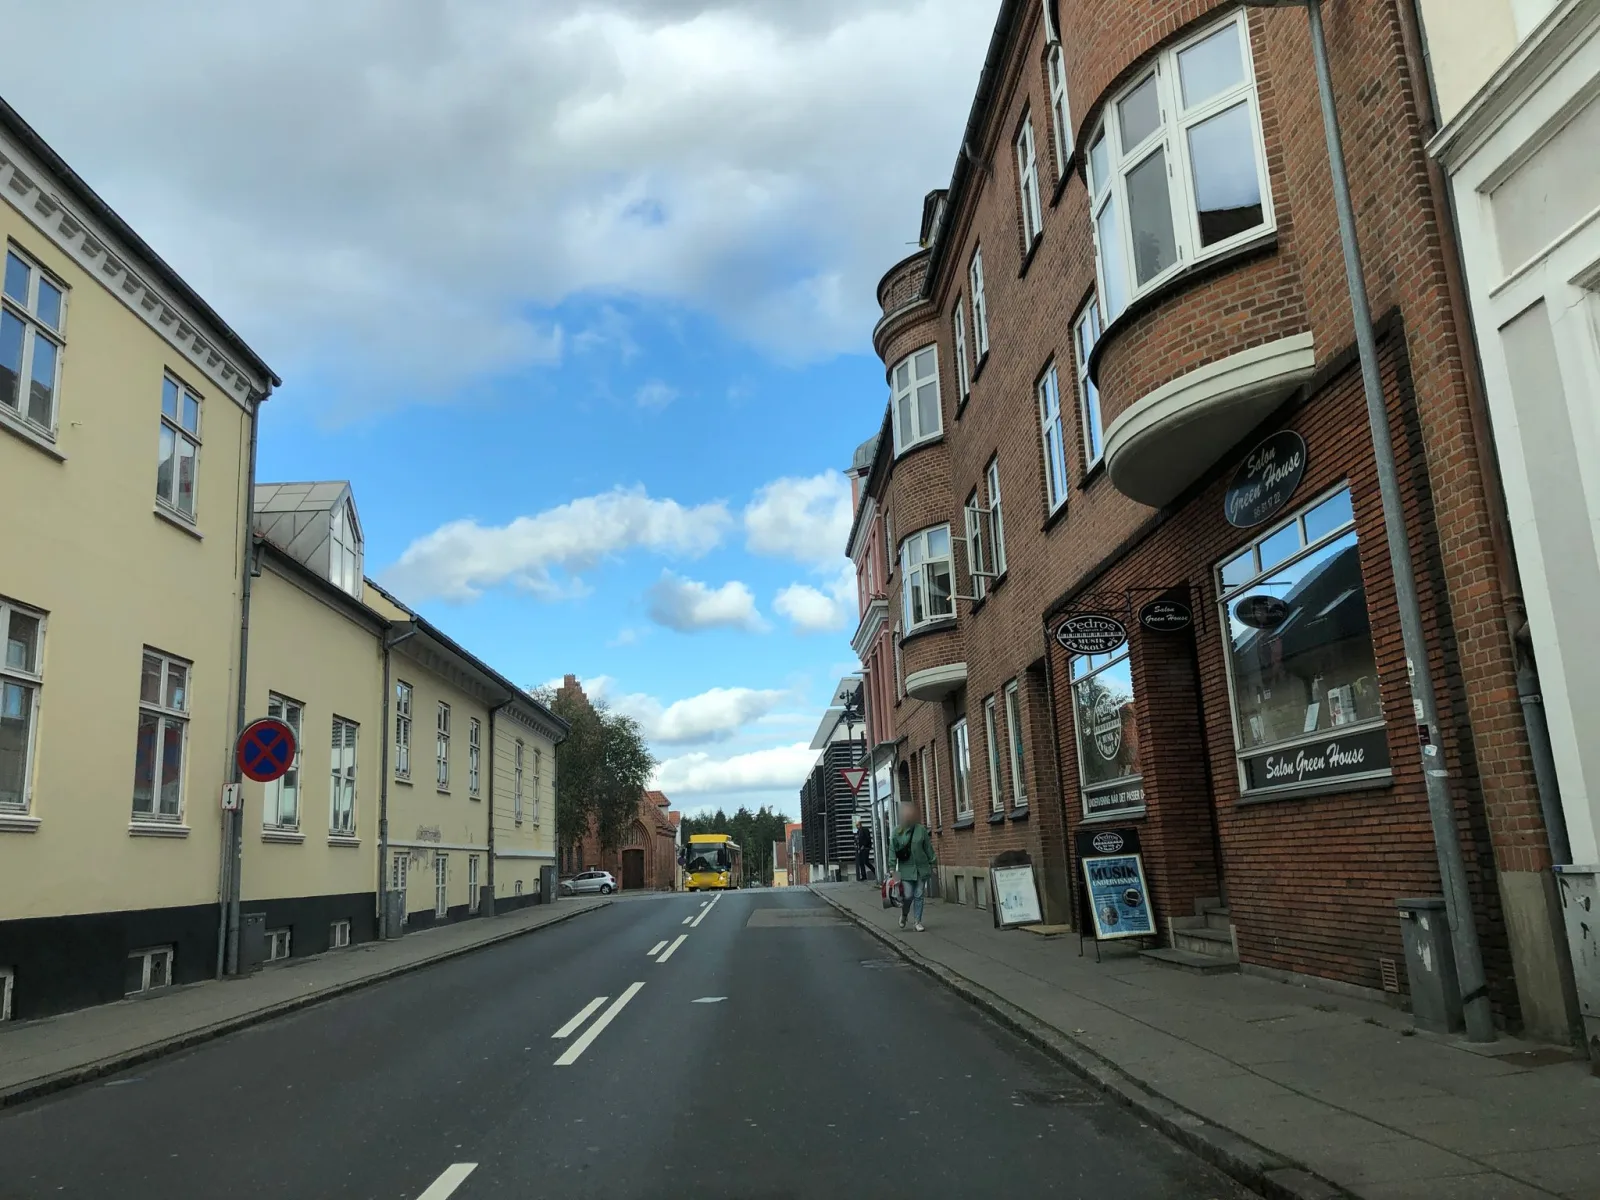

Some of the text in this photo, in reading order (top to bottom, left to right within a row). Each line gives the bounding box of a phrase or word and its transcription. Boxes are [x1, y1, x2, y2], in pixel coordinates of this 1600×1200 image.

[1247, 446, 1275, 478] Salon
[1230, 451, 1301, 523] Green House
[1154, 605, 1175, 613] Salon
[1066, 618, 1116, 633] Pedros
[1145, 613, 1188, 624] Green House
[1266, 743, 1365, 781] Salon Green House
[1091, 866, 1138, 880] MUSIK
[1092, 877, 1140, 887] UNDERVISNING
